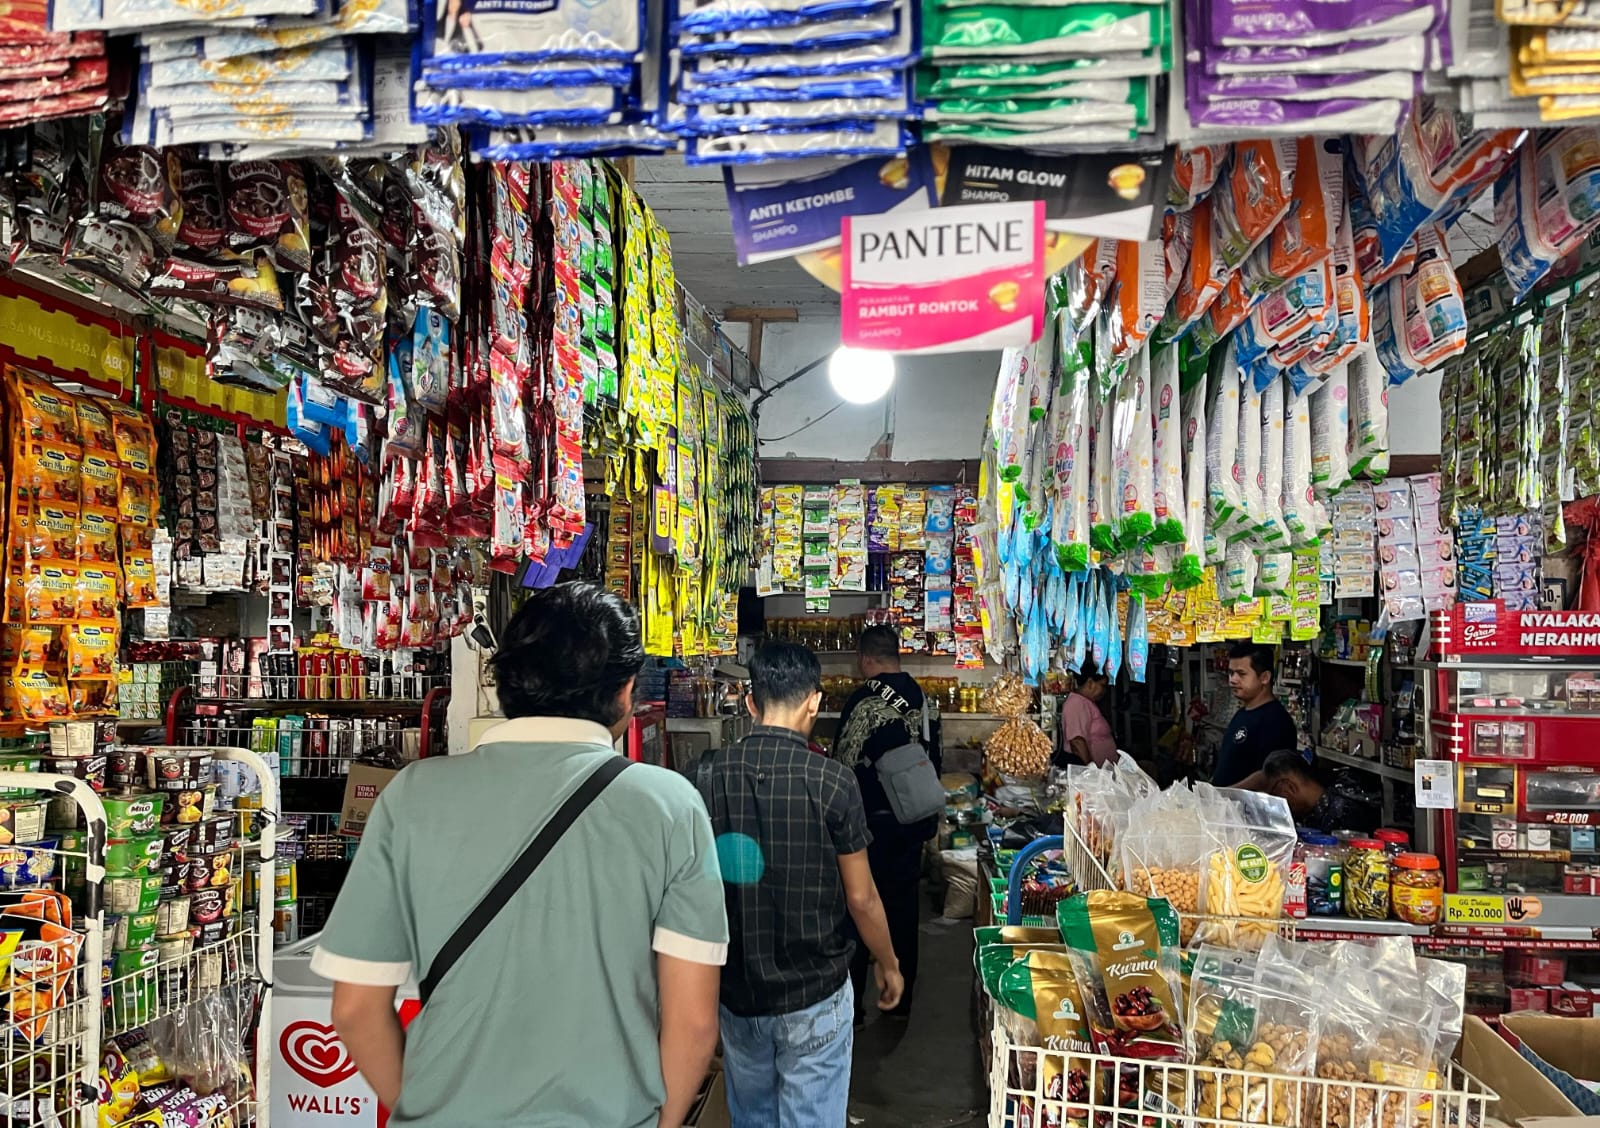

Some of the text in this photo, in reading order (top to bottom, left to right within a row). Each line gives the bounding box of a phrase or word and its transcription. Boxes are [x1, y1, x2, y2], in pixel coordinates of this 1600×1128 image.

[965, 164, 1066, 187] HITAM GLOW
[961, 189, 1010, 202] SHAMPO
[749, 187, 855, 222] ANTI KETOMBE
[751, 224, 798, 243] SHAMPO
[859, 219, 1023, 264] PANTENE
[859, 300, 979, 319] RAMBUT RONTOK
[859, 326, 902, 339] SHAMPO
[104, 354, 126, 371] ABC
[1464, 625, 1496, 640] Garam
[356, 785, 375, 793] TORA
[130, 804, 151, 814] MILO
[1458, 898, 1469, 906] GG
[1449, 907, 1503, 920] Rp. 20.000
[1105, 960, 1158, 977] Kurma
[1044, 1034, 1092, 1052] Kurma
[287, 1093, 361, 1115] WALL'S
